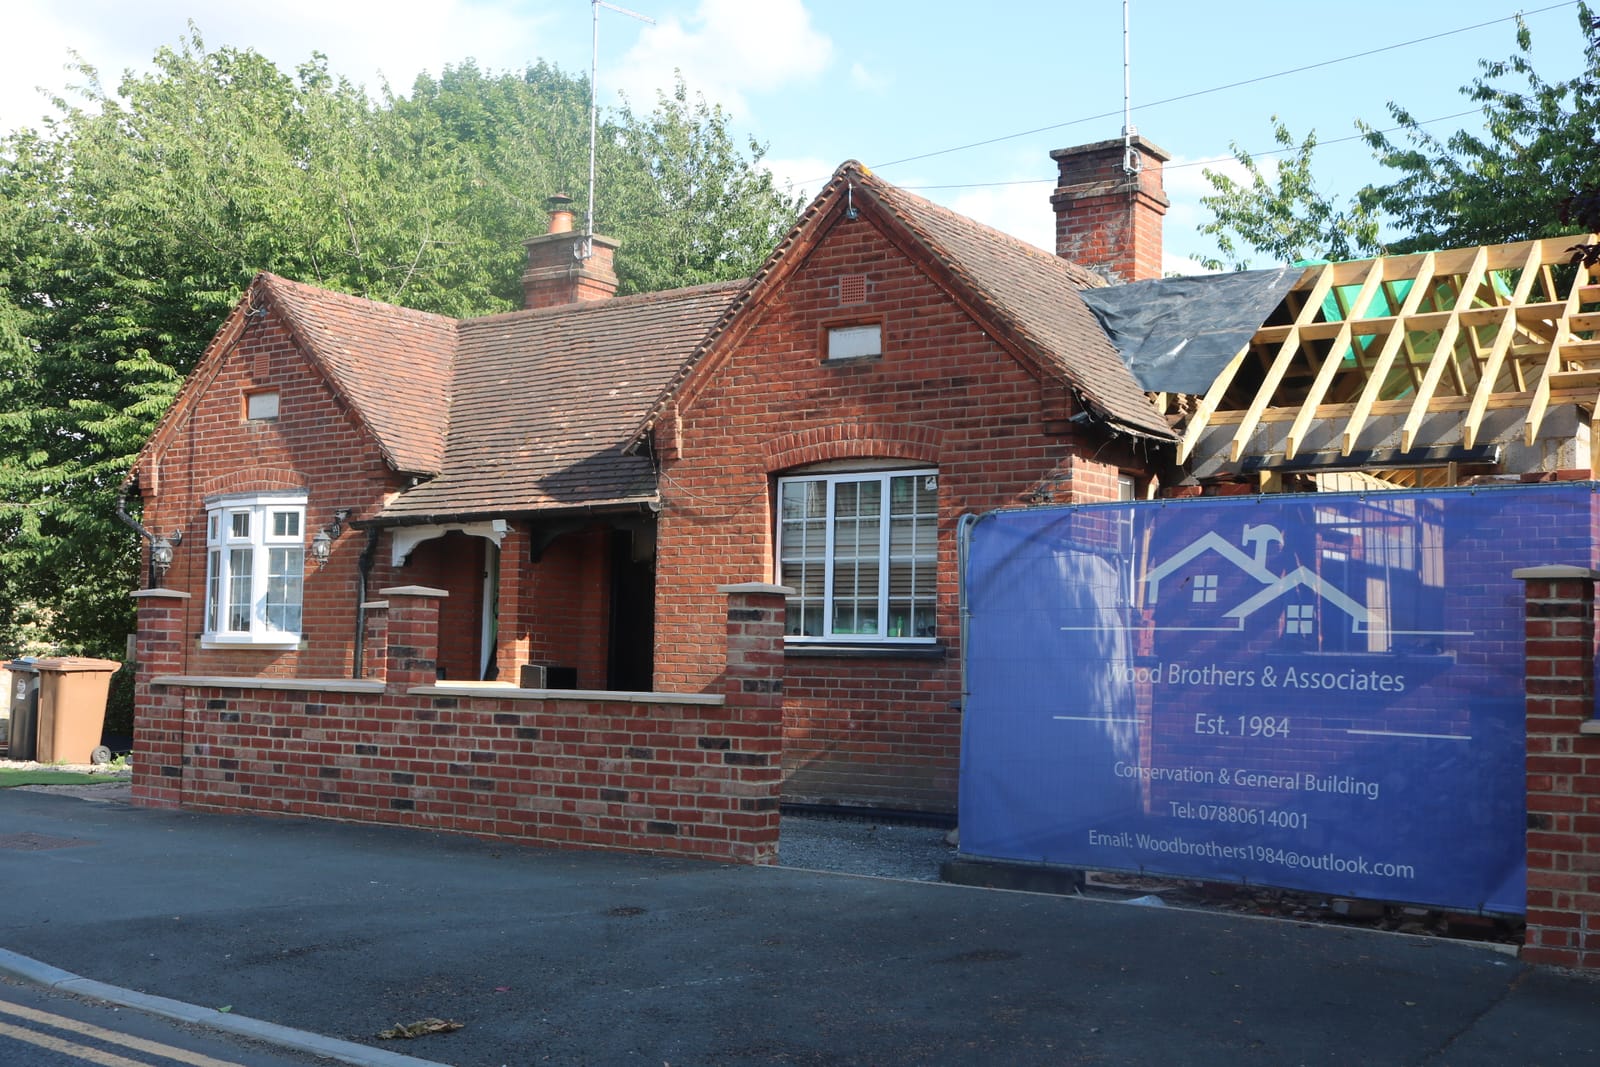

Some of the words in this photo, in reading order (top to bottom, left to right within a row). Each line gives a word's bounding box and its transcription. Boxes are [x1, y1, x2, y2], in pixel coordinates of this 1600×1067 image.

[1106, 662, 1162, 684] Wood
[1168, 664, 1255, 687] Brothers
[1262, 666, 1277, 687] &
[1283, 667, 1405, 692] Associates
[1195, 713, 1230, 736] Est.
[1237, 715, 1290, 738] 1984
[1114, 761, 1214, 785] Conservation
[1218, 767, 1231, 785] &
[1234, 768, 1300, 791] General
[1305, 774, 1380, 801] Building
[1169, 801, 1196, 820] Tel:
[1199, 805, 1309, 830] 07880614001
[1088, 830, 1134, 849] Email:
[1136, 833, 1415, 879] Woodbrothers1984@outlook.com
